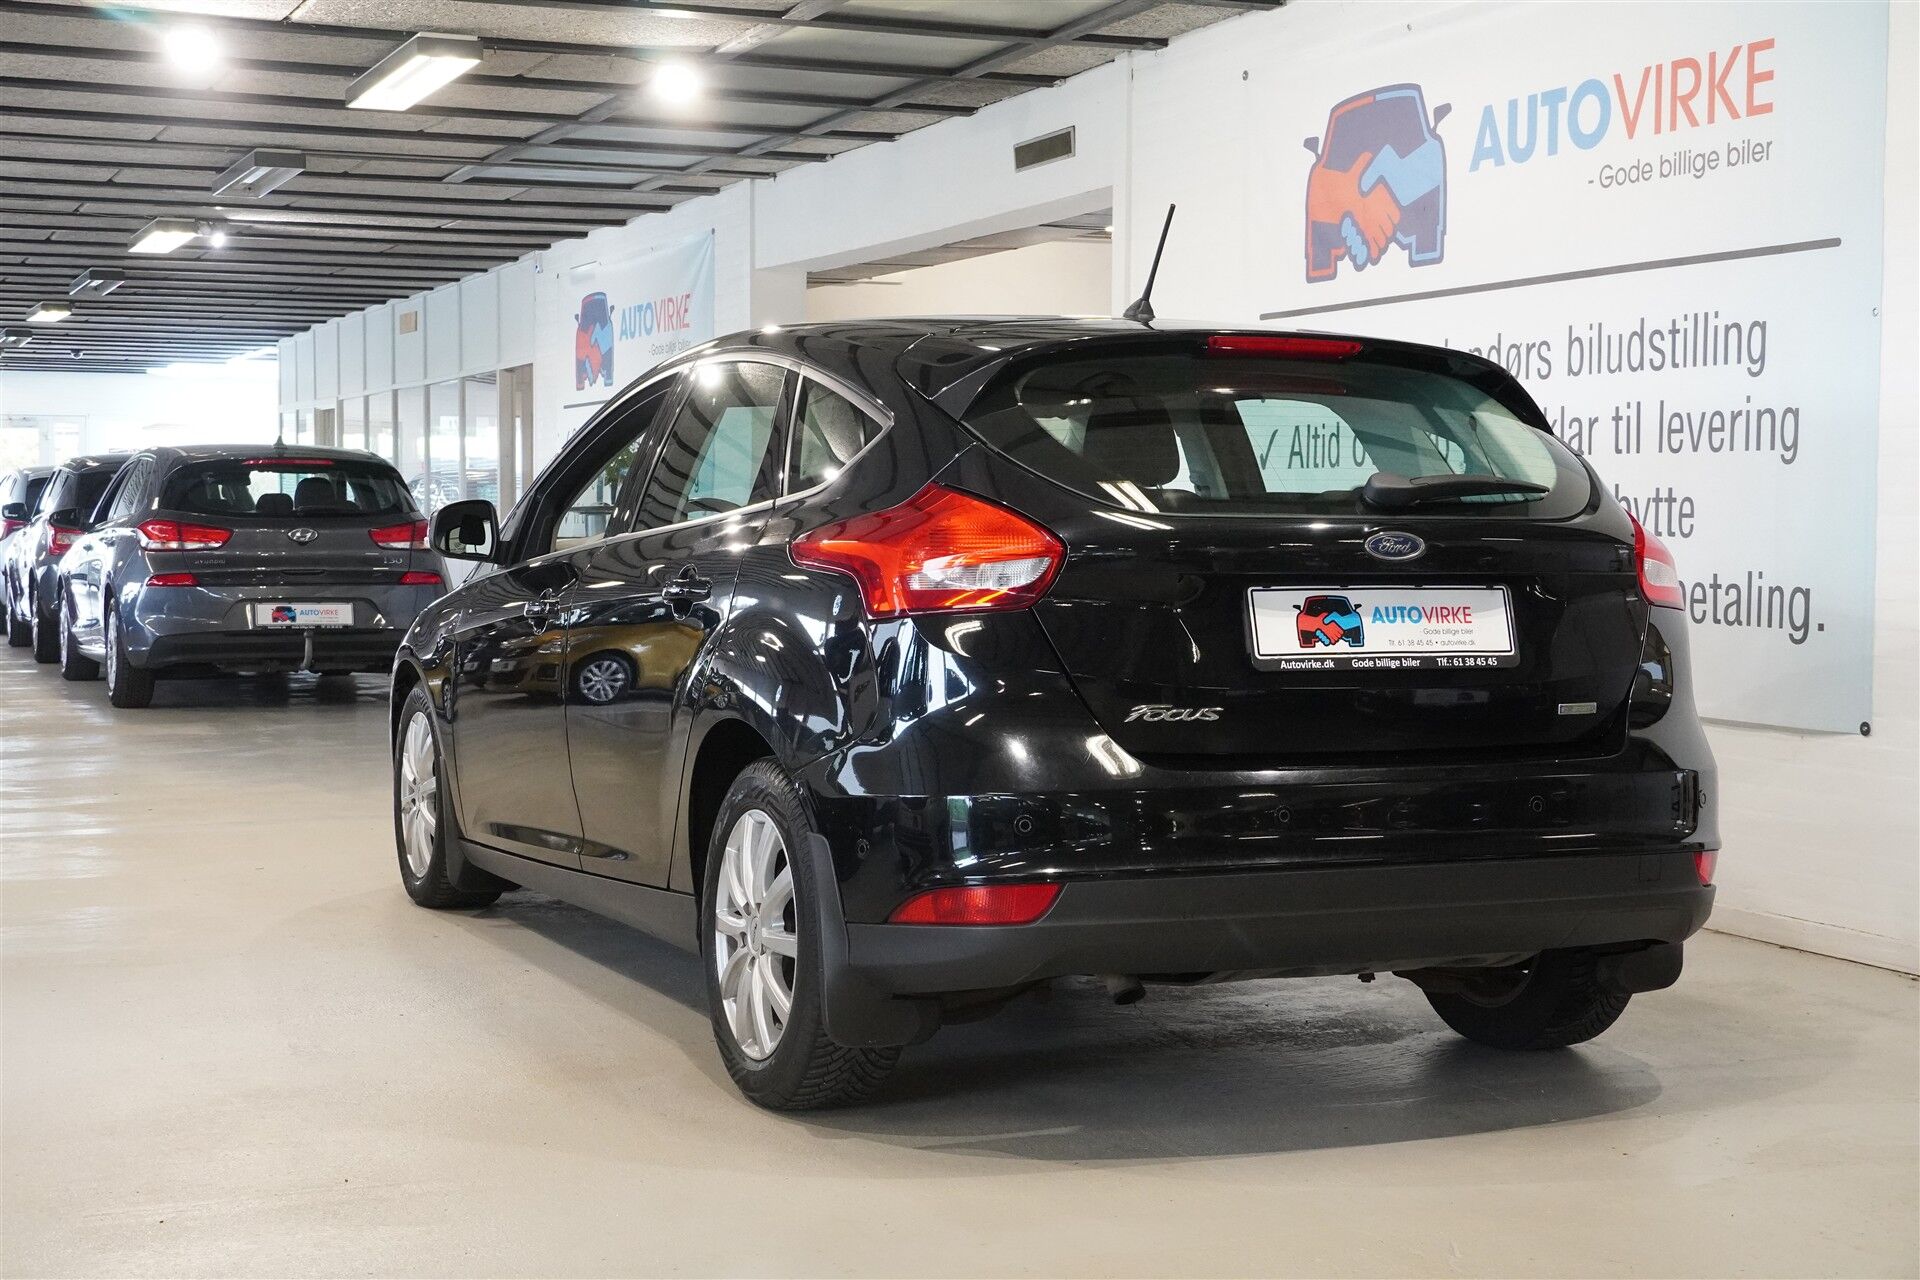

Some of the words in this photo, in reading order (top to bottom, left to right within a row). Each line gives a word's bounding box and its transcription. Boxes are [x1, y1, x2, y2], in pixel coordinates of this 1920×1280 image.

[1469, 37, 1775, 173] AUTOVIRKE
[1599, 159, 1653, 188] Gode
[1659, 149, 1720, 179] billige
[1727, 138, 1773, 167] biler
[619, 293, 691, 341] AUTOVIRKE
[1567, 310, 1767, 378] biludstilling
[1287, 421, 1341, 470] Altid
[1611, 401, 1641, 455] til
[1658, 395, 1800, 465] levering
[1377, 535, 1412, 554] Ford
[299, 608, 339, 616] AUTOVIRKE
[1371, 605, 1473, 624] AUTOVIRKE
[1280, 659, 1335, 670] Autovirke.dk
[1351, 658, 1375, 668] Gode
[1376, 658, 1400, 669] billige
[1402, 658, 1421, 668] biler
[1453, 657, 1463, 667] 61
[1464, 657, 1475, 667] 38
[1476, 657, 1486, 666] 45
[1487, 657, 1498, 666] 45
